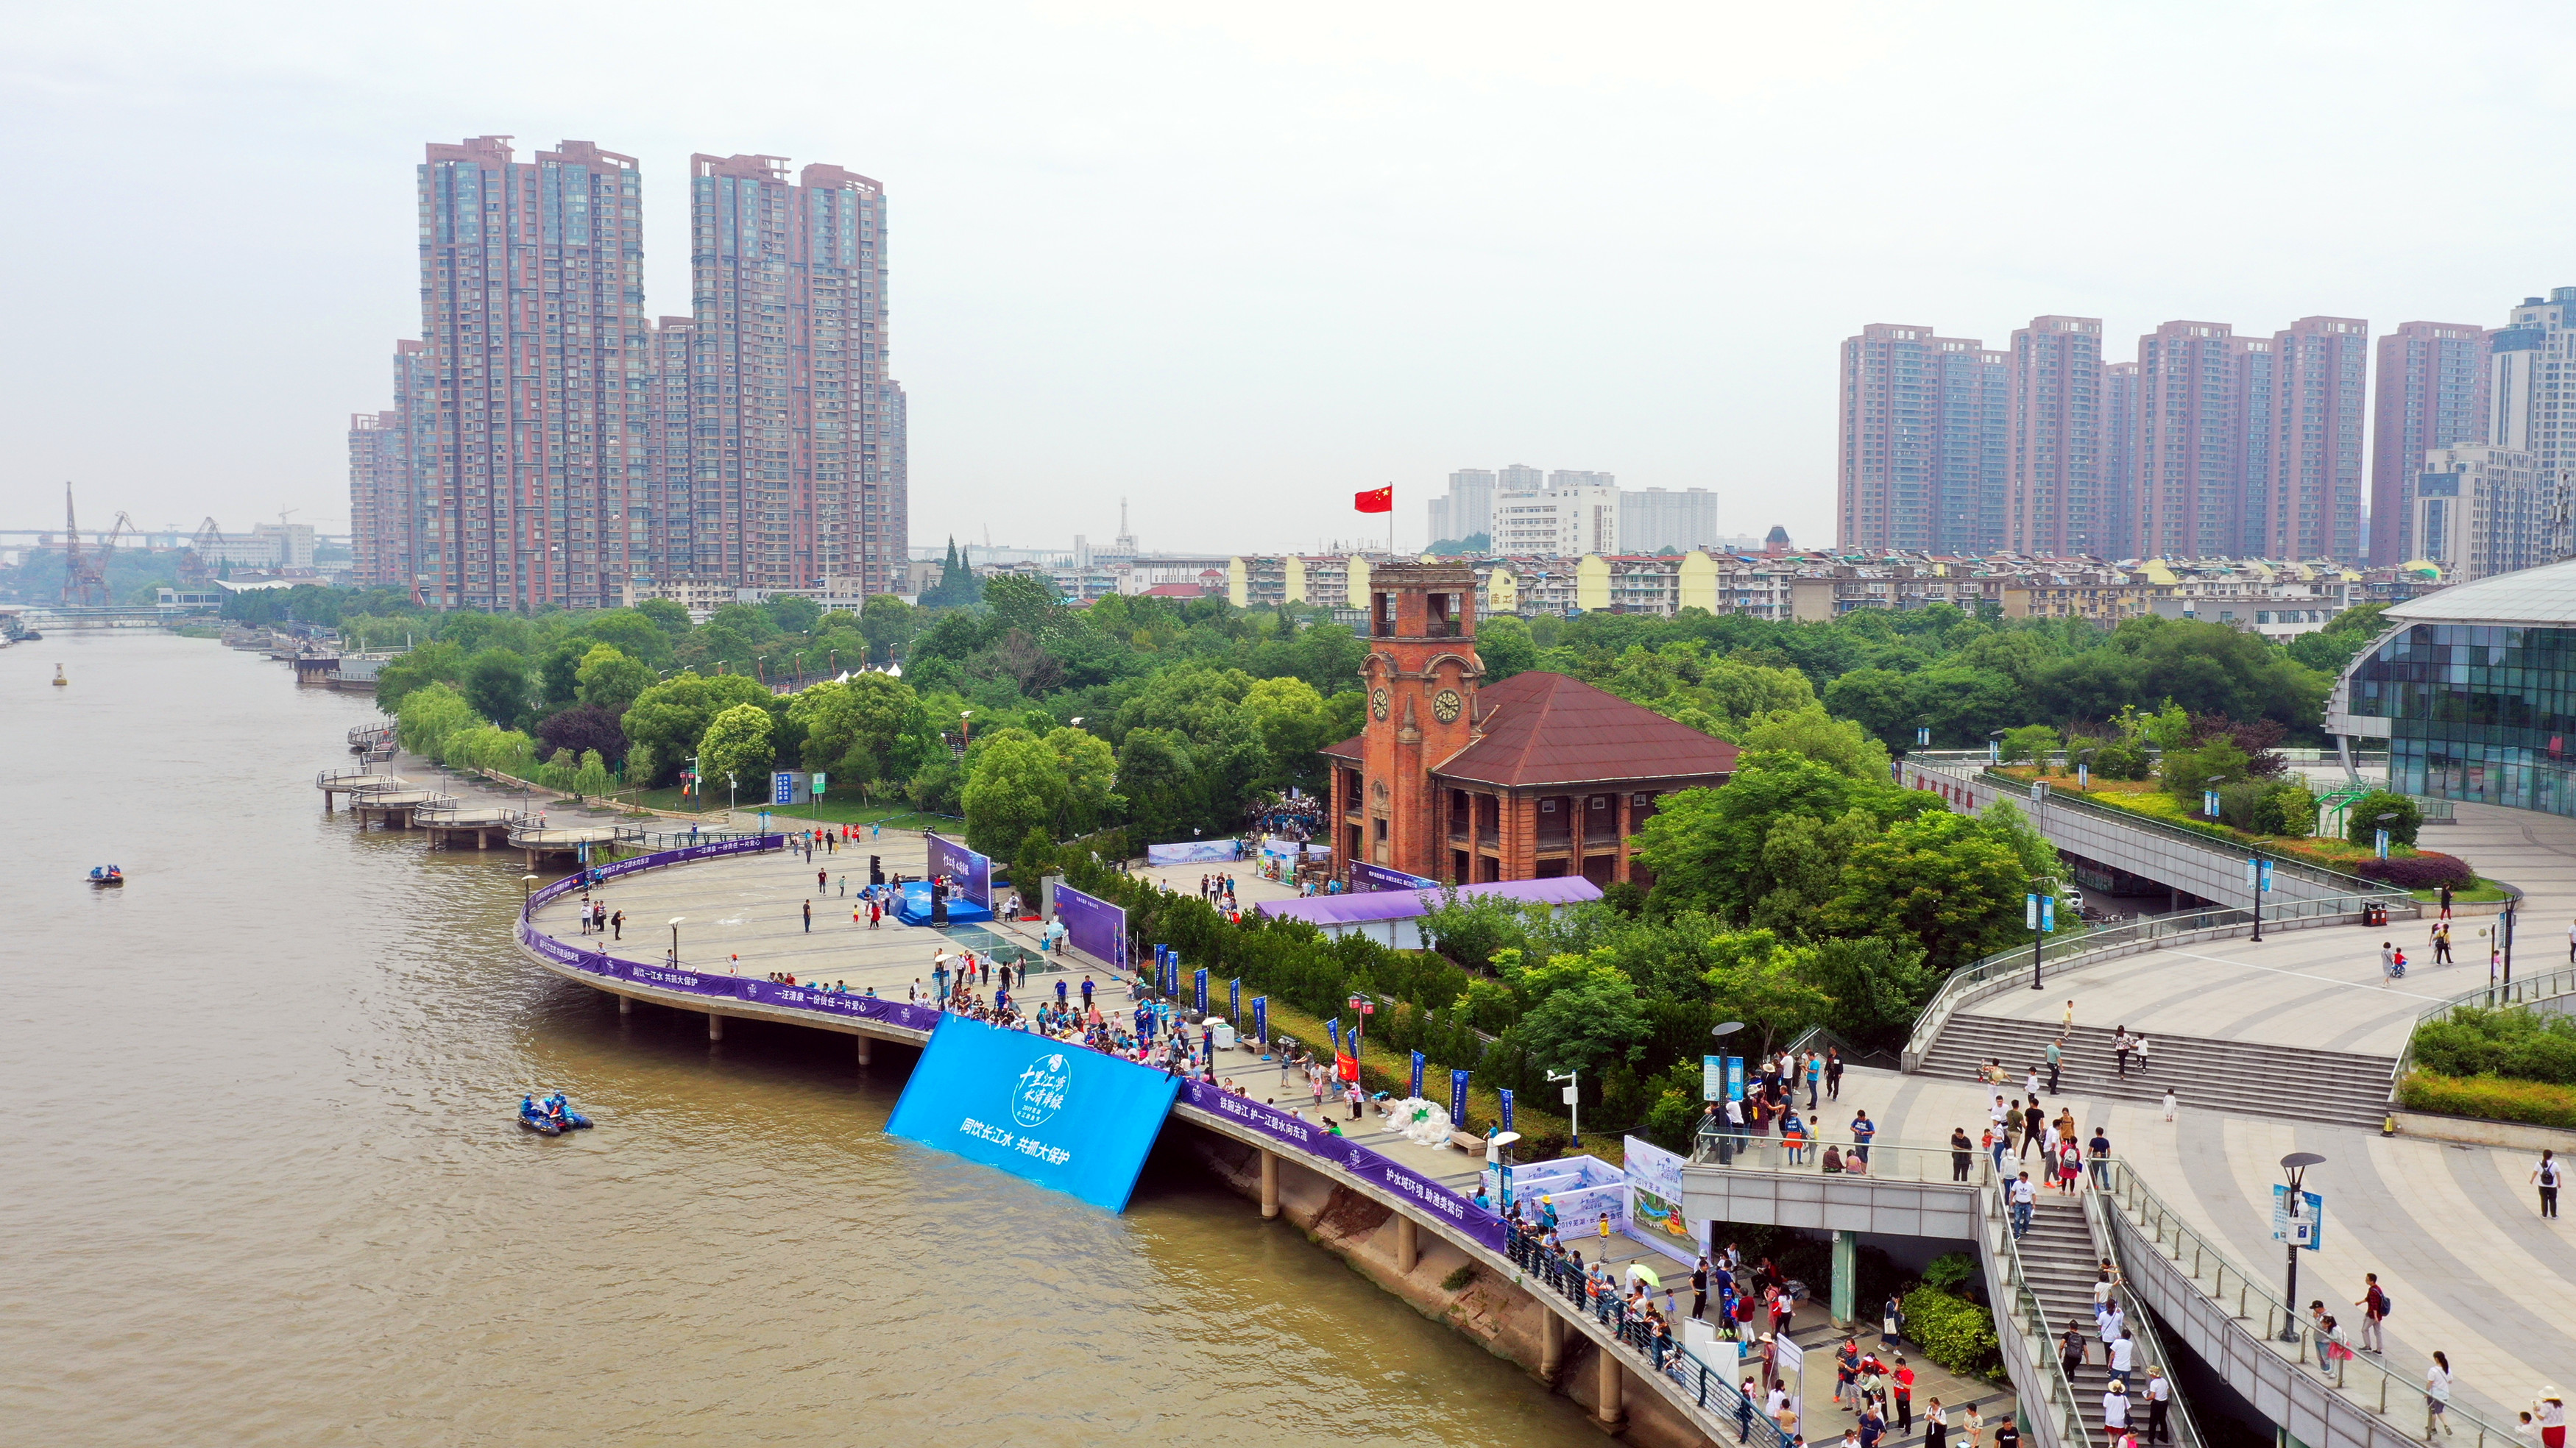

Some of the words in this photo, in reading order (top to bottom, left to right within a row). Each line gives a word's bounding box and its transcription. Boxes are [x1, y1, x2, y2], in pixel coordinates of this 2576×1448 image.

[633, 967, 663, 981] 同饮一江水
[665, 973, 698, 987] 共抓大保护
[774, 990, 804, 1002] 一汪清泉
[807, 994, 835, 1007] 一份责任
[837, 998, 866, 1012] 一片爱心
[1018, 1064, 1066, 1092] 十里江湾
[1022, 1087, 1064, 1110] 水清岸绿
[1220, 1096, 1249, 1118] 铁腕治江
[1250, 1108, 1308, 1142] 护一江碧水向东流
[959, 1117, 1014, 1148] 同饮长江水
[1014, 1138, 1070, 1165] 共抓大保护
[1386, 1167, 1424, 1199] 护水域环境
[1424, 1188, 1464, 1220] 助渔类繁衍
[1557, 1212, 1622, 1229] 2019芜湖·长江鱼节
